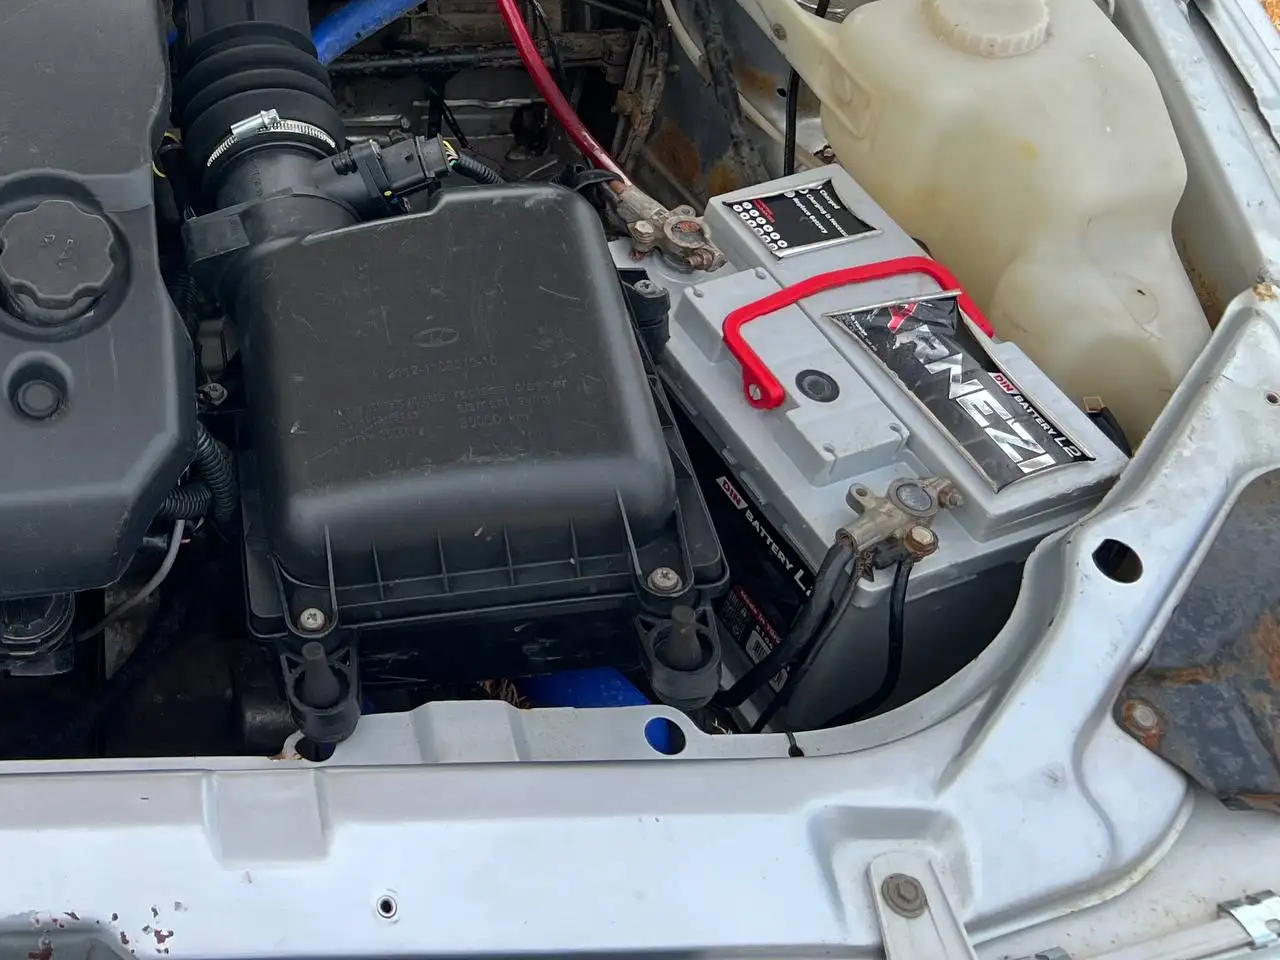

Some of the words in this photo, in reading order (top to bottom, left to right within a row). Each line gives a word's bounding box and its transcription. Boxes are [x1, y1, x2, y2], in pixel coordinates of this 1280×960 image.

[994, 373, 1015, 393] DIN
[1014, 393, 1057, 436] BATTERY
[1054, 435, 1082, 457] L2
[722, 479, 742, 507] DIN
[745, 509, 794, 571] BATTERY
